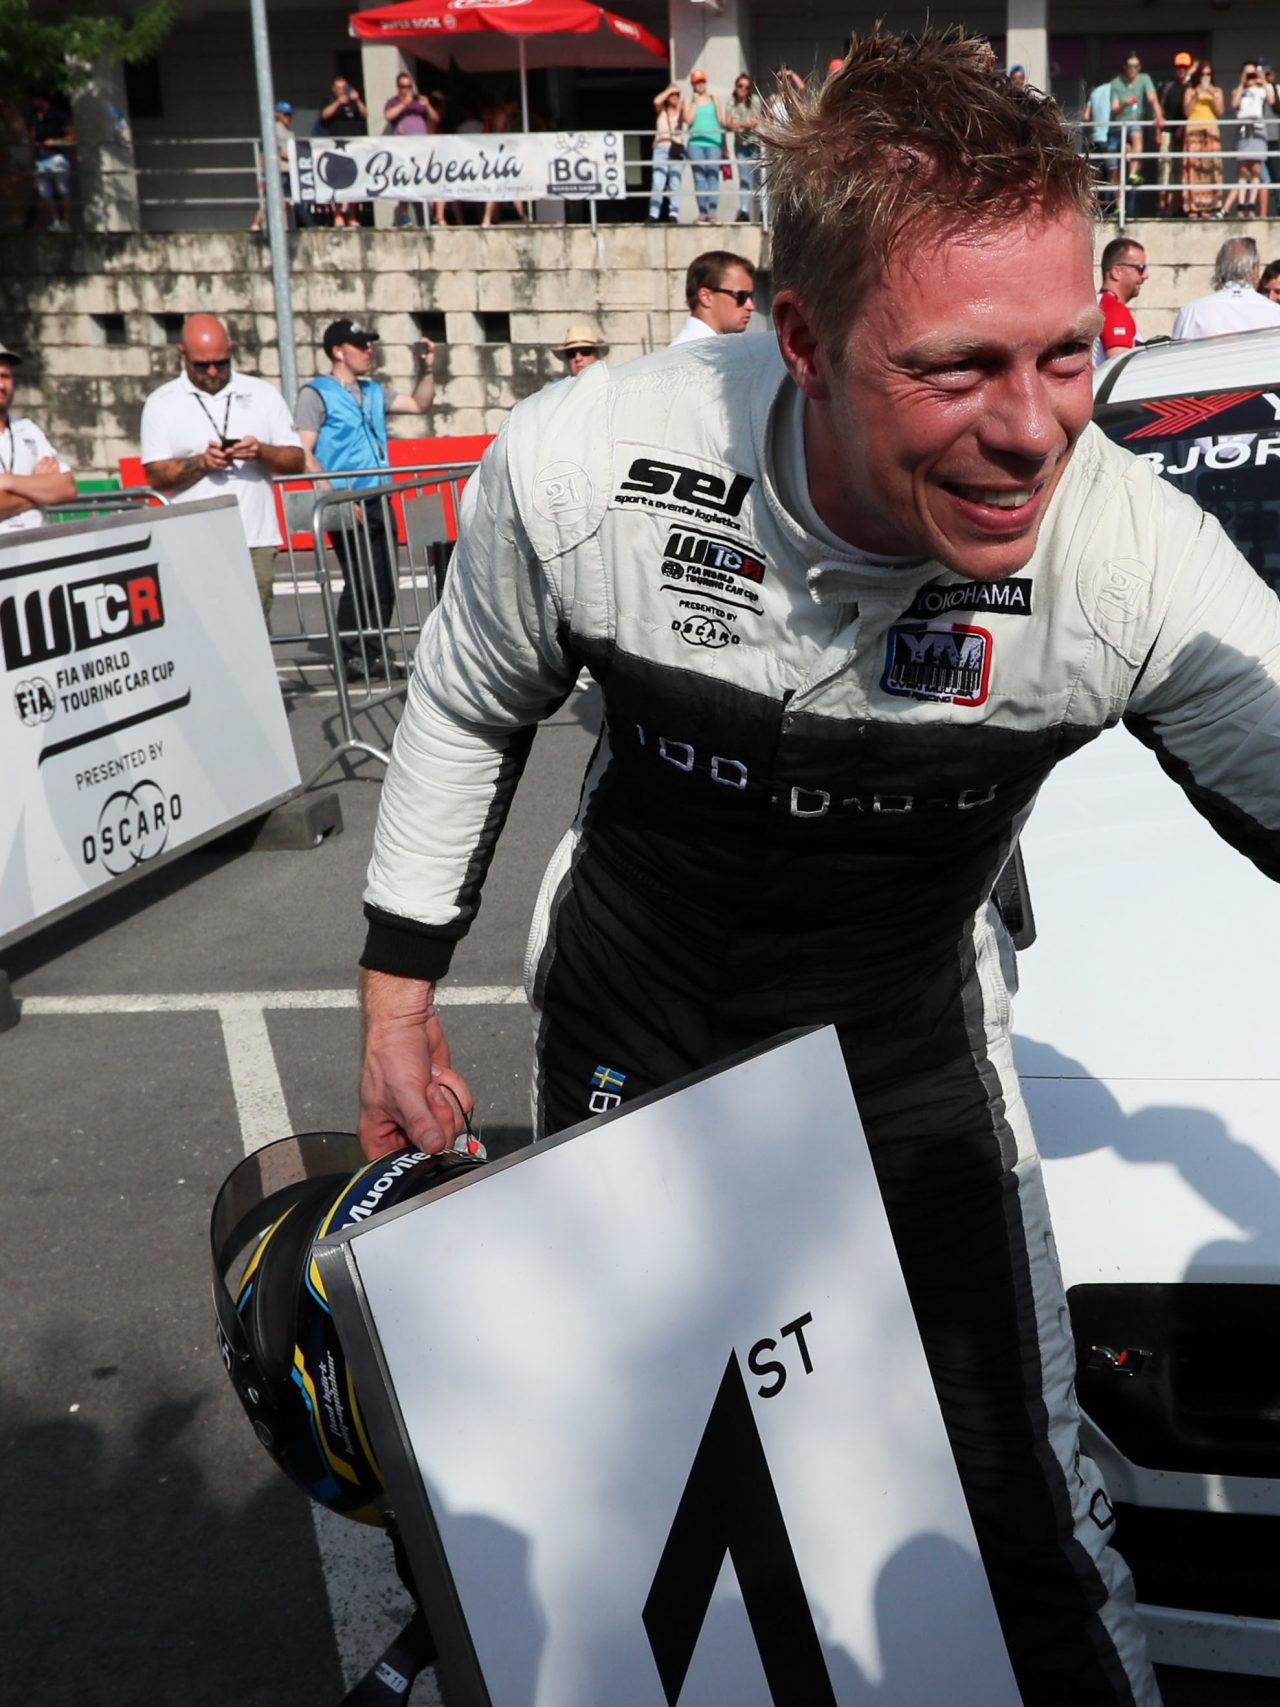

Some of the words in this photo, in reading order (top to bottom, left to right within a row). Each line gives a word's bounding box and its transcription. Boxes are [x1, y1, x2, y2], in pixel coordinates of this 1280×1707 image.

[299, 157, 314, 200] BAR
[554, 158, 592, 181] BG
[614, 494, 648, 505] sport
[655, 501, 694, 515] events
[695, 508, 741, 531] logistics
[725, 584, 743, 597] CAR
[679, 599, 726, 618] PRESENTED
[726, 612, 738, 622] BY
[56, 668, 80, 688] FIA
[81, 651, 131, 681] WORLD
[61, 679, 122, 713] TOURING
[125, 670, 150, 691] CAR
[152, 661, 175, 682] CUP
[76, 749, 146, 791] PRESENTED
[148, 740, 163, 761] BY
[83, 794, 181, 864] OSCARO
